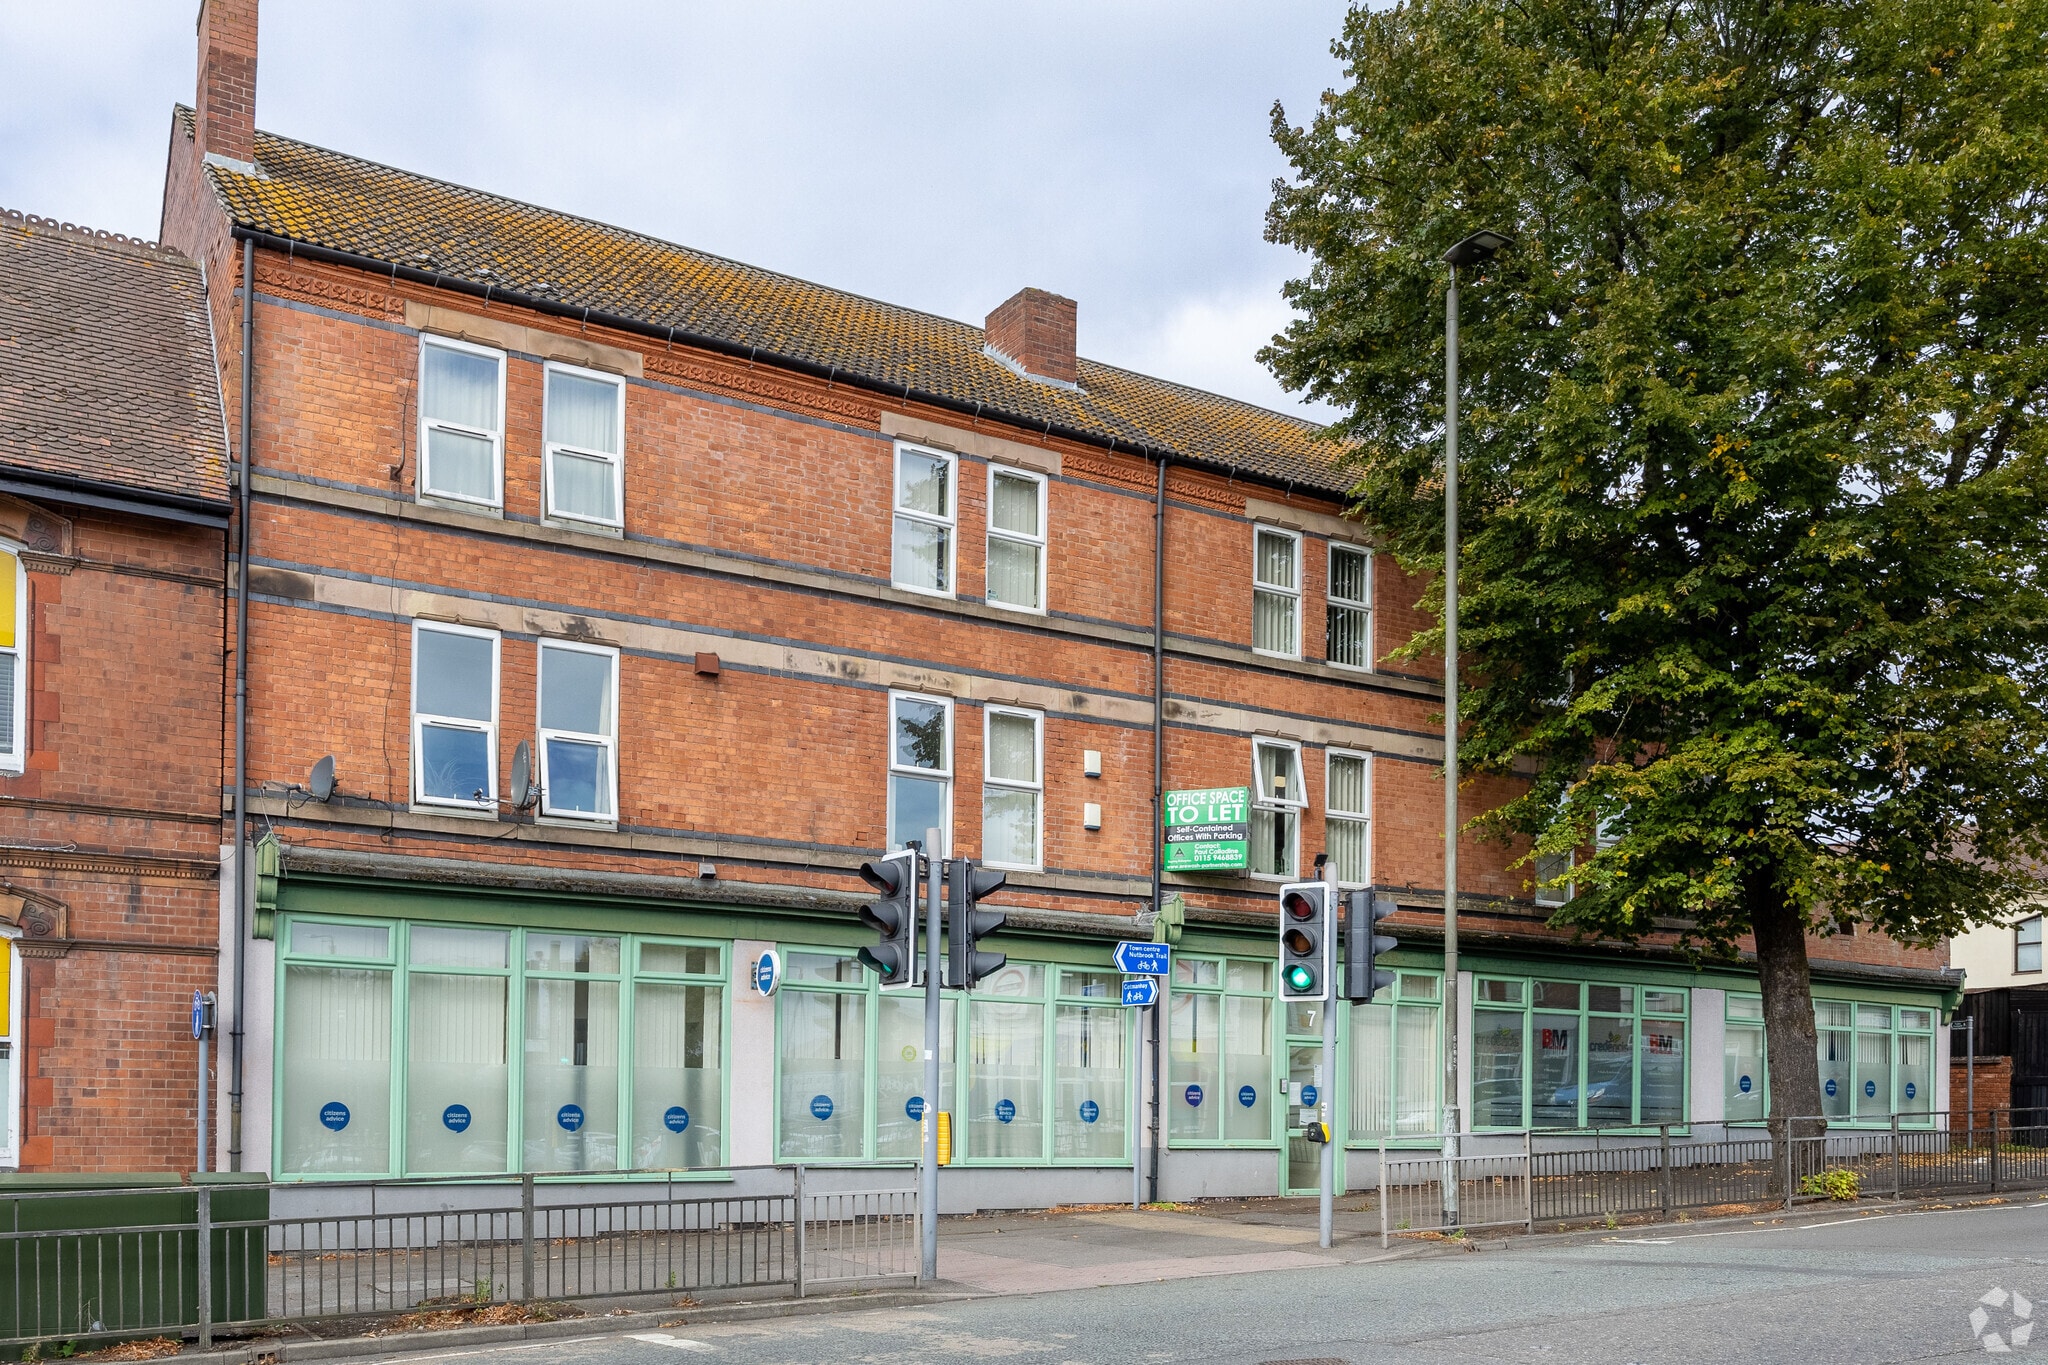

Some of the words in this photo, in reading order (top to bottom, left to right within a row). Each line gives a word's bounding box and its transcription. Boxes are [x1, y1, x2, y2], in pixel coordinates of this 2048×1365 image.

[1167, 792, 1206, 806] OFFICE
[1209, 790, 1245, 804] SPACE
[1167, 806, 1199, 824] TO
[1208, 804, 1244, 821] LET
[1176, 824, 1234, 833] Self-Contained
[1167, 834, 1194, 842] Offices
[1195, 832, 1212, 840] With
[1213, 832, 1243, 840] Parking
[1307, 1010, 1317, 1027] 7
[1542, 1029, 1567, 1049] BM
